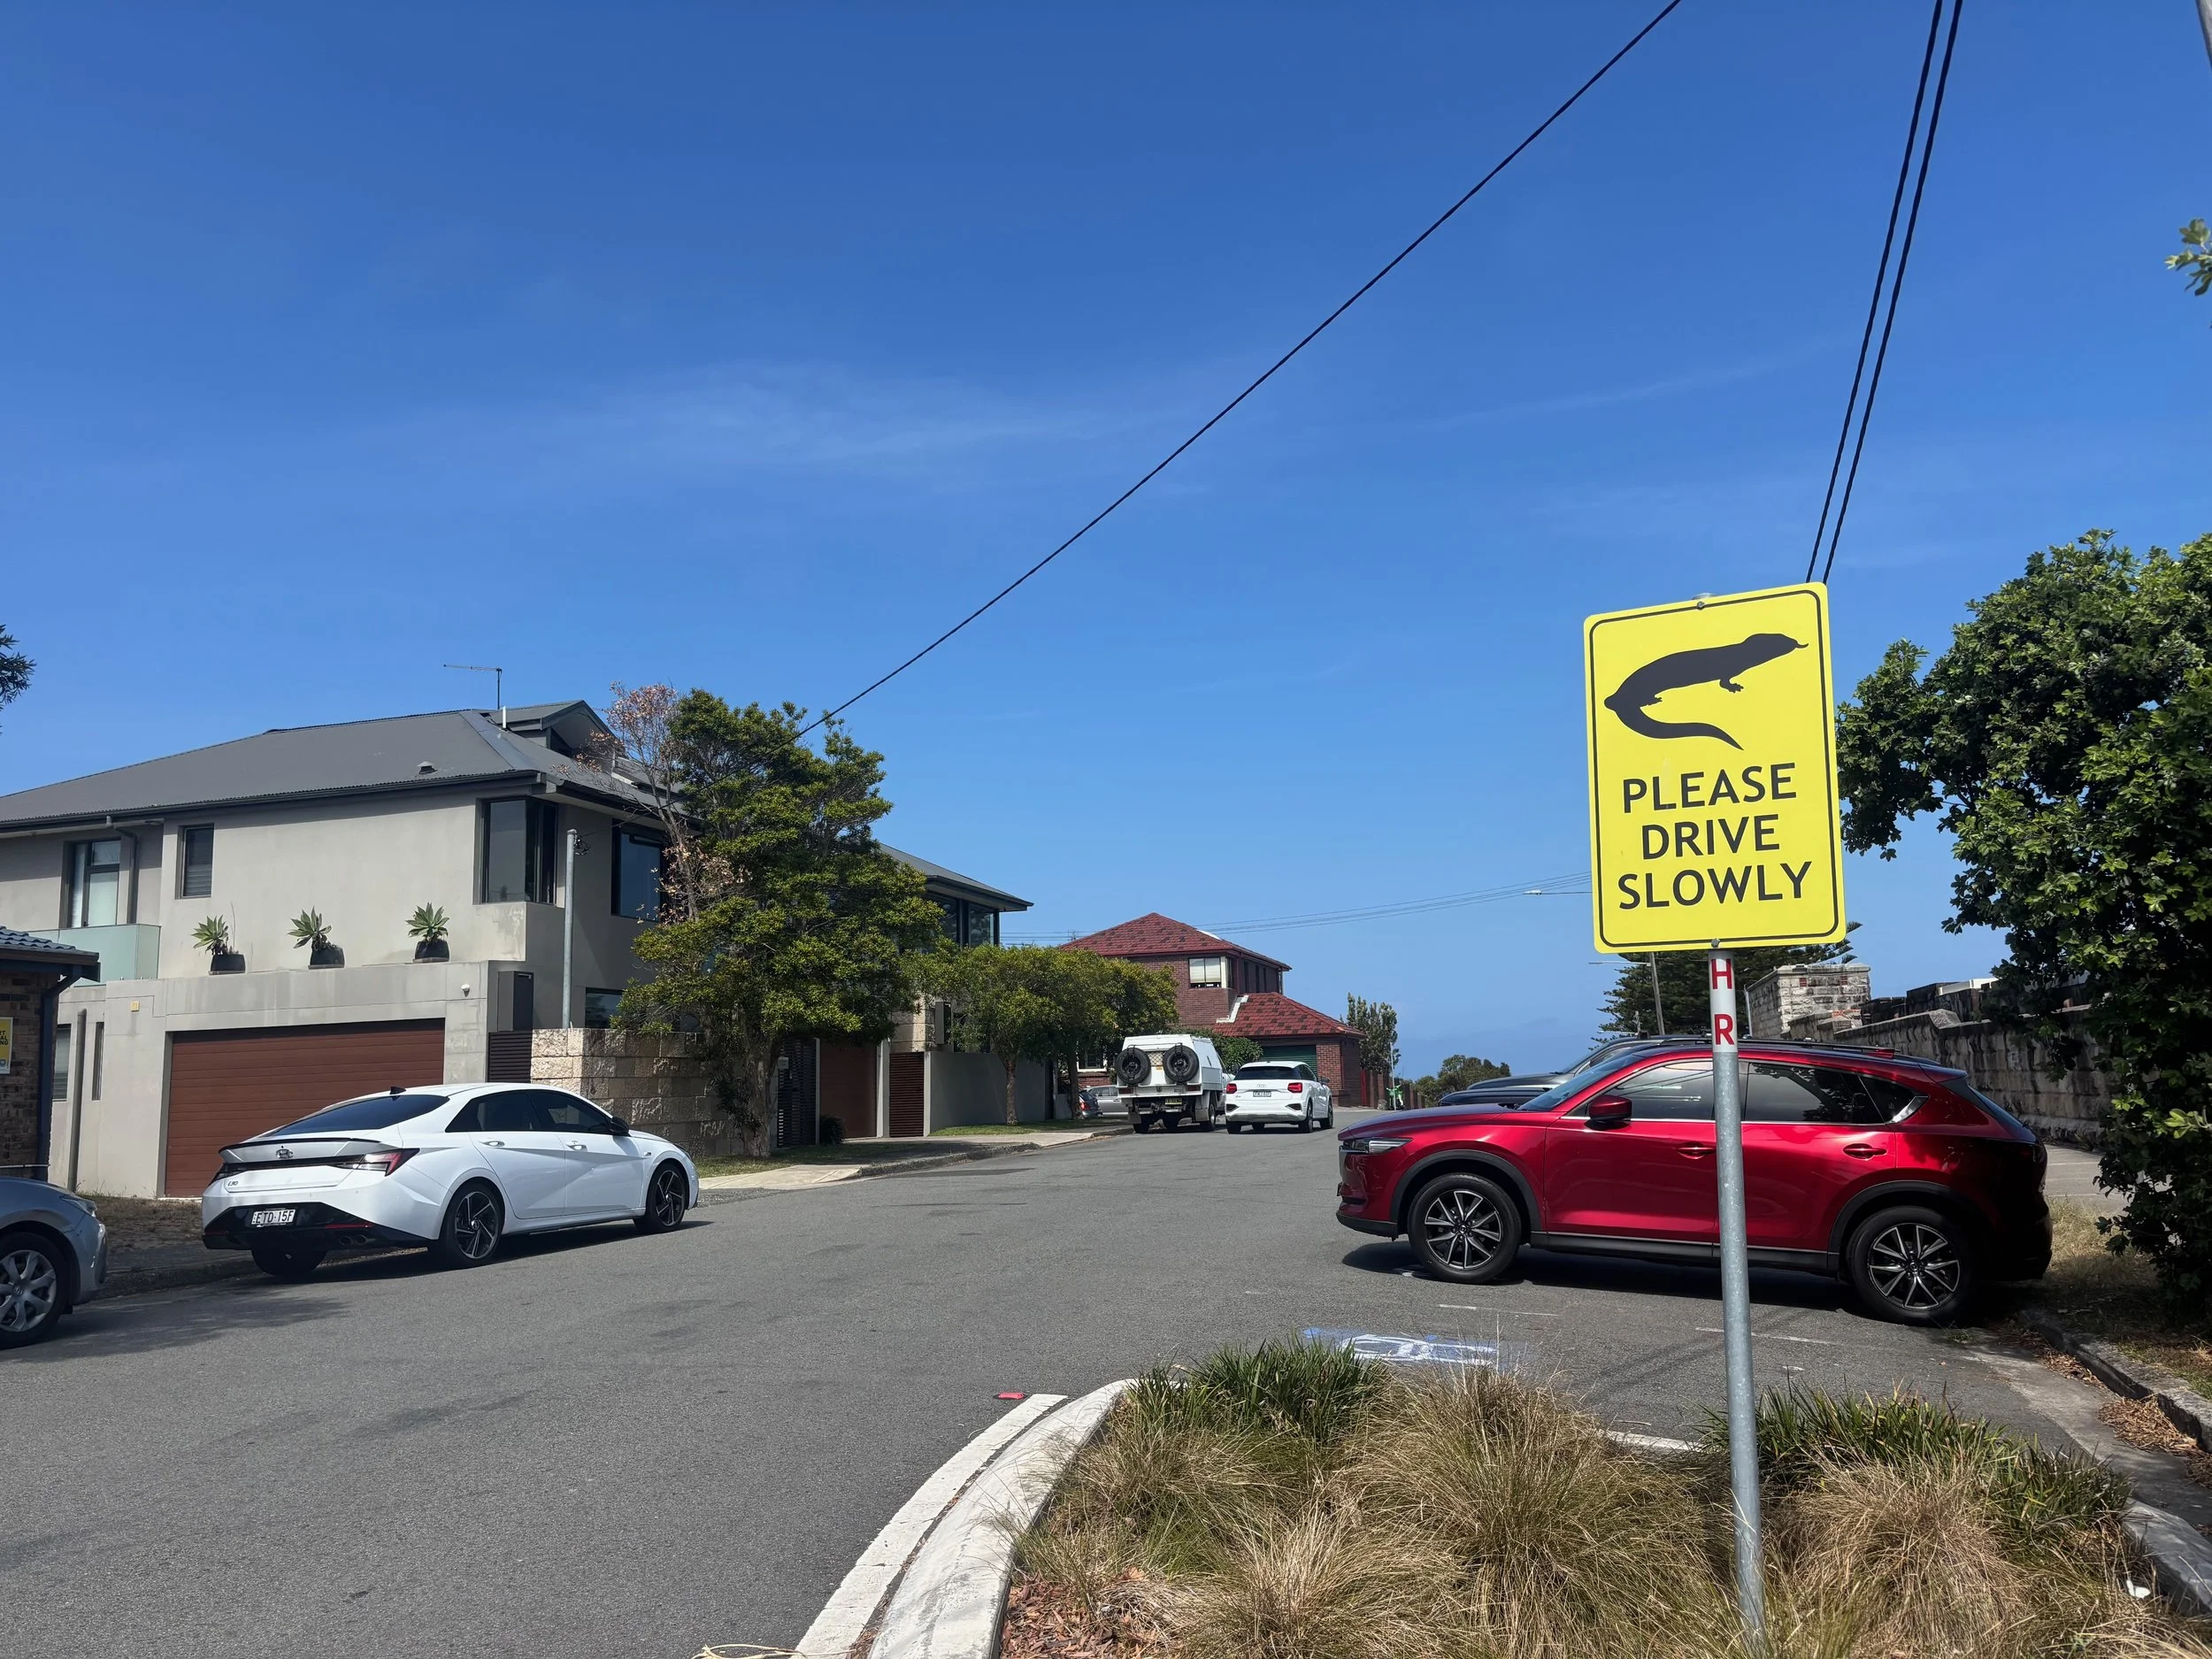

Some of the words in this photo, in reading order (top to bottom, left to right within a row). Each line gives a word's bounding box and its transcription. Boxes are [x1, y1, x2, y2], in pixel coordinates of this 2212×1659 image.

[1623, 763, 1797, 813] PLEASE
[1642, 814, 1779, 860] DRIVE
[1618, 861, 1812, 910] SLOWLY
